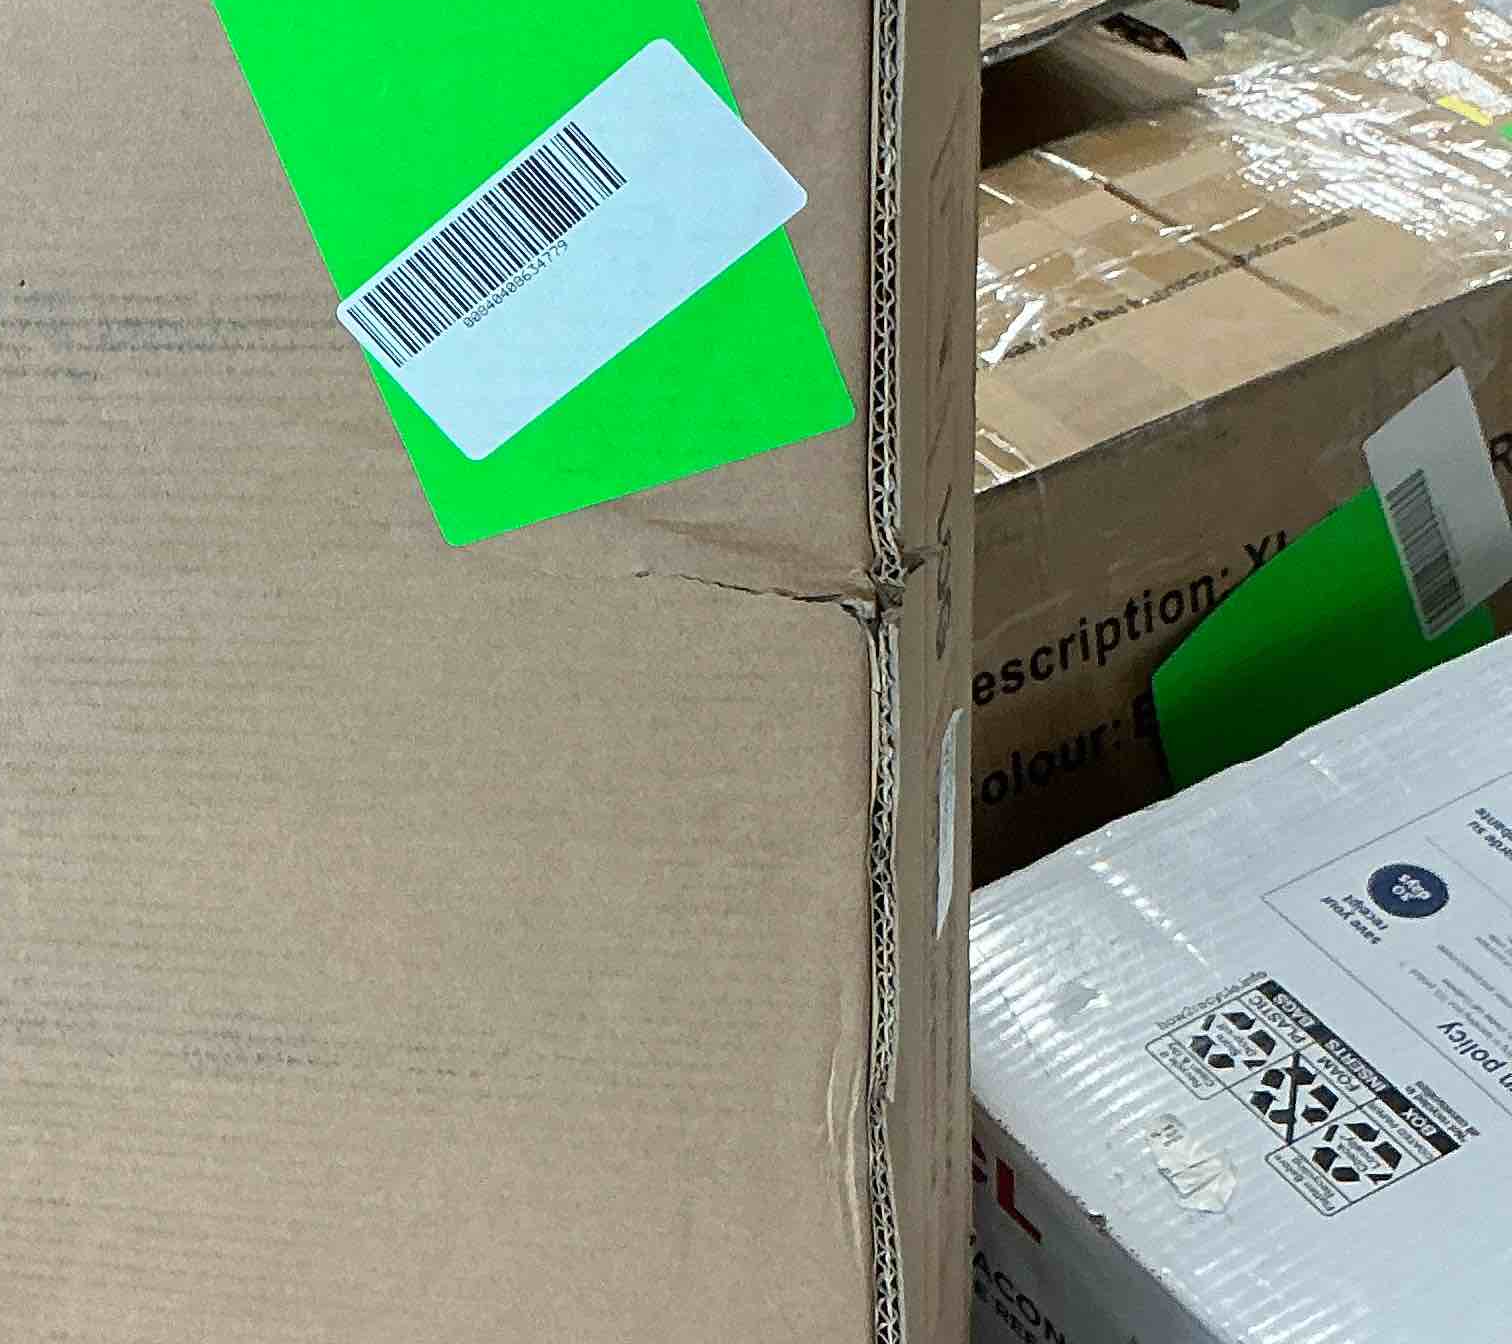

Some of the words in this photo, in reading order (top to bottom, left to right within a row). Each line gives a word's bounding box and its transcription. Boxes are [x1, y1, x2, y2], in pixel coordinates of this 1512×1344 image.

[972, 566, 1229, 706] escription:
[980, 718, 1122, 805] olour:
[1317, 895, 1353, 919] your
[1341, 892, 1389, 930] receipt
[1348, 916, 1381, 945] save
[1247, 993, 1306, 1043] PLASTIC
[1436, 1022, 1508, 1072] policy
[1316, 1054, 1360, 1091] FOAM
[1400, 1104, 1437, 1135] BOX
